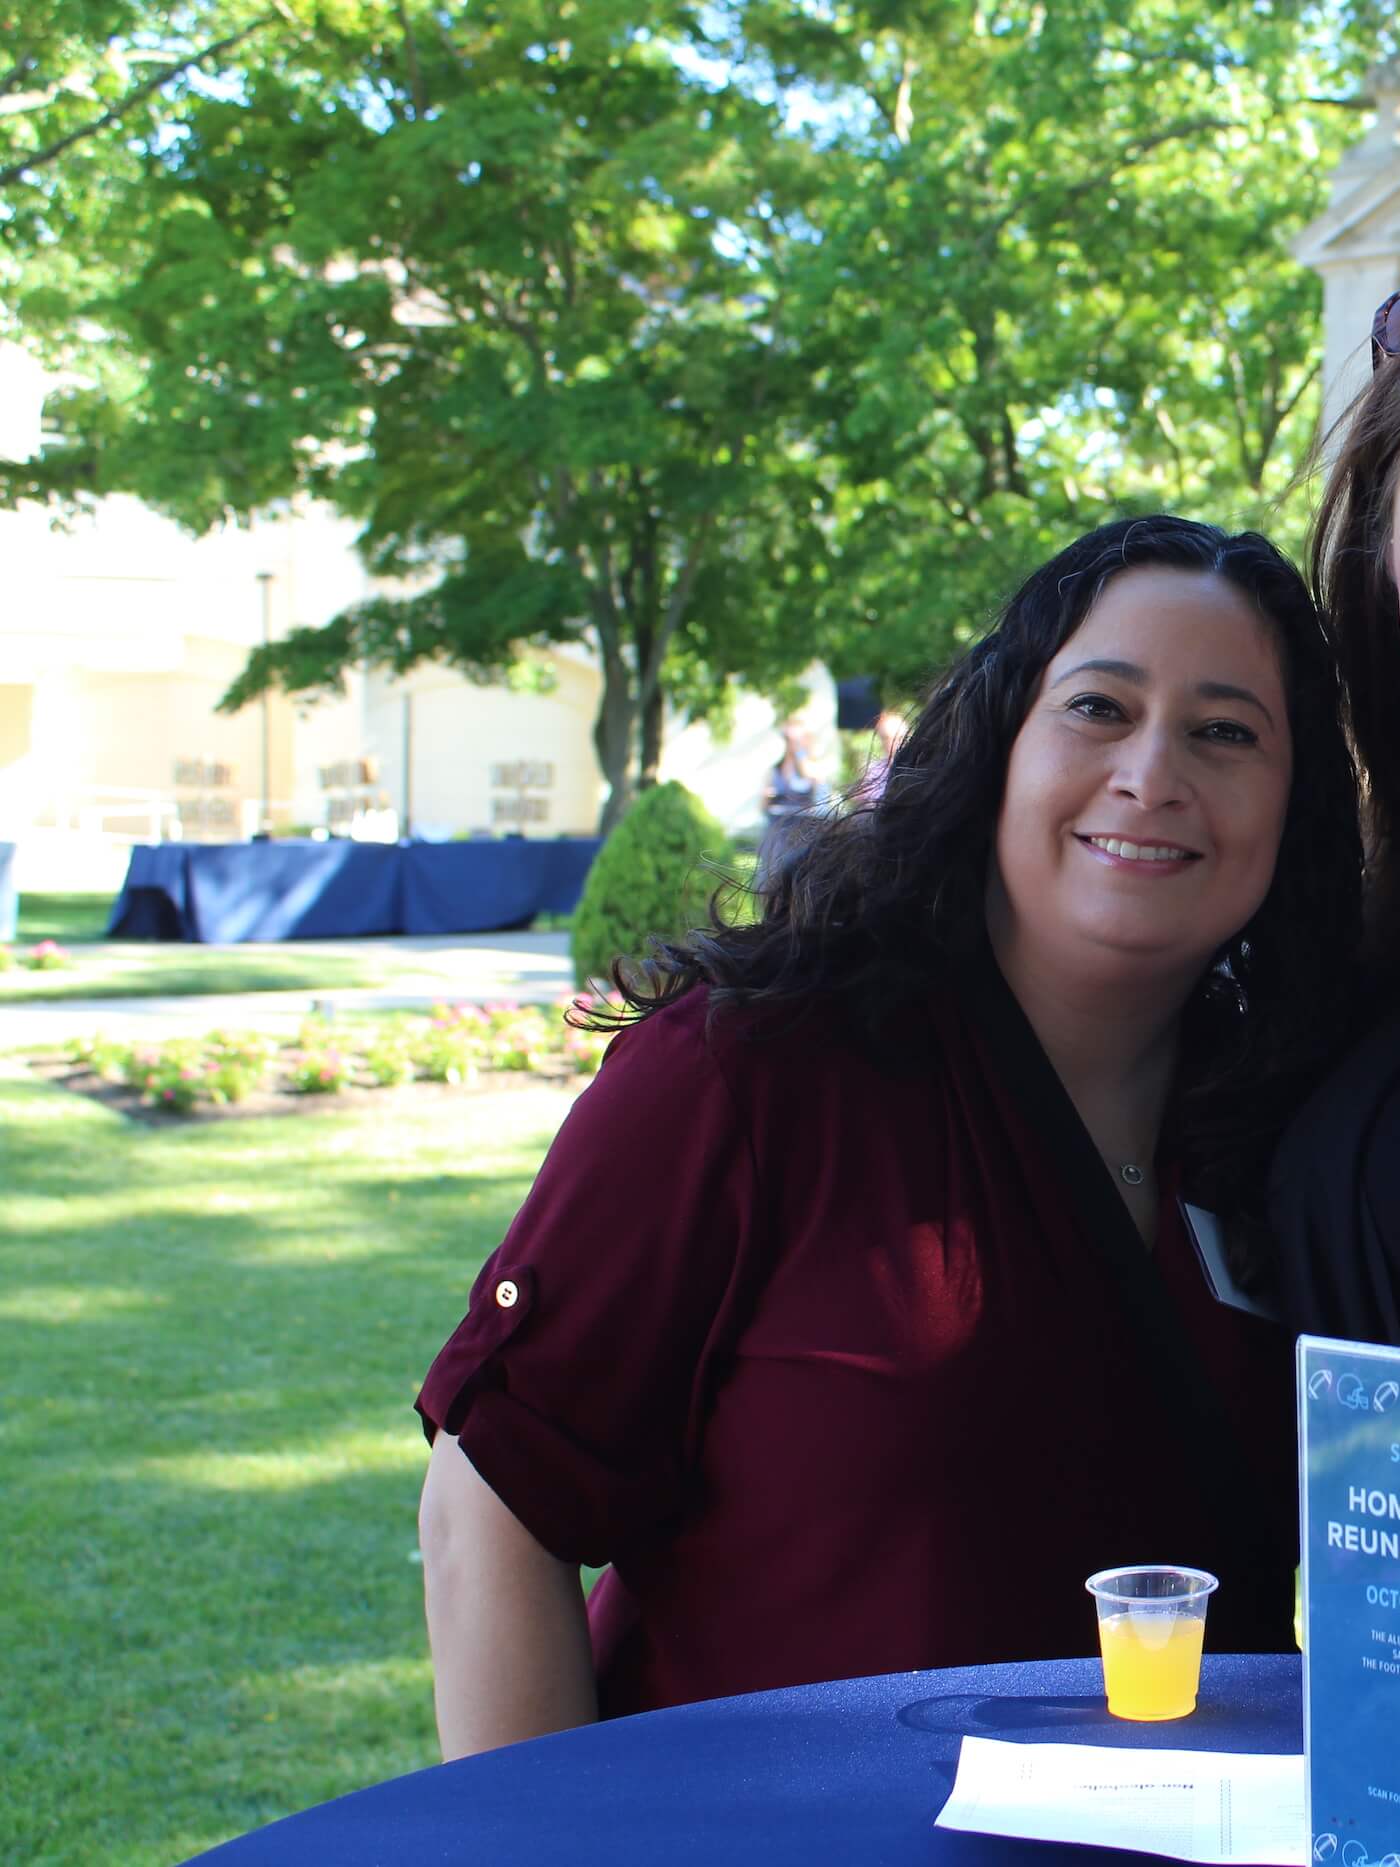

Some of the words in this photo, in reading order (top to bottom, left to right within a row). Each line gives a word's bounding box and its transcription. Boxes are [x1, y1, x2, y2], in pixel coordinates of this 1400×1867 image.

[1371, 1629, 1386, 1642] THE
[1362, 1656, 1377, 1670] THE
[1368, 1786, 1388, 1801] SCAN
